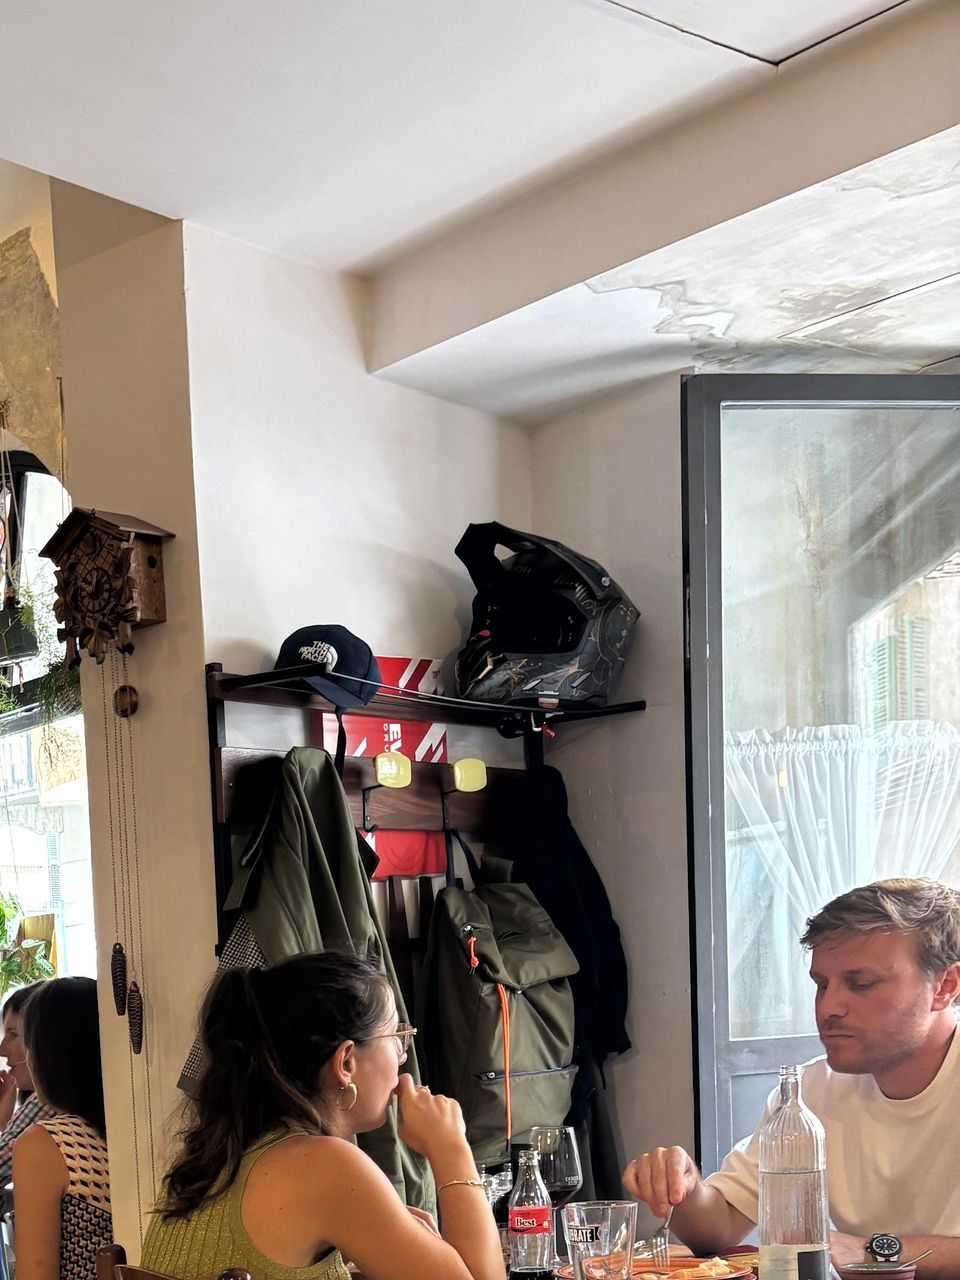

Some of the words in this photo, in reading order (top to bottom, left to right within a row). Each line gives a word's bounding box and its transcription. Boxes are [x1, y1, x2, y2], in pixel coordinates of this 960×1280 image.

[312, 640, 330, 651] THE
[298, 646, 328, 658] NORTH
[300, 652, 324, 663] FACE
[515, 1217, 537, 1228] Best
